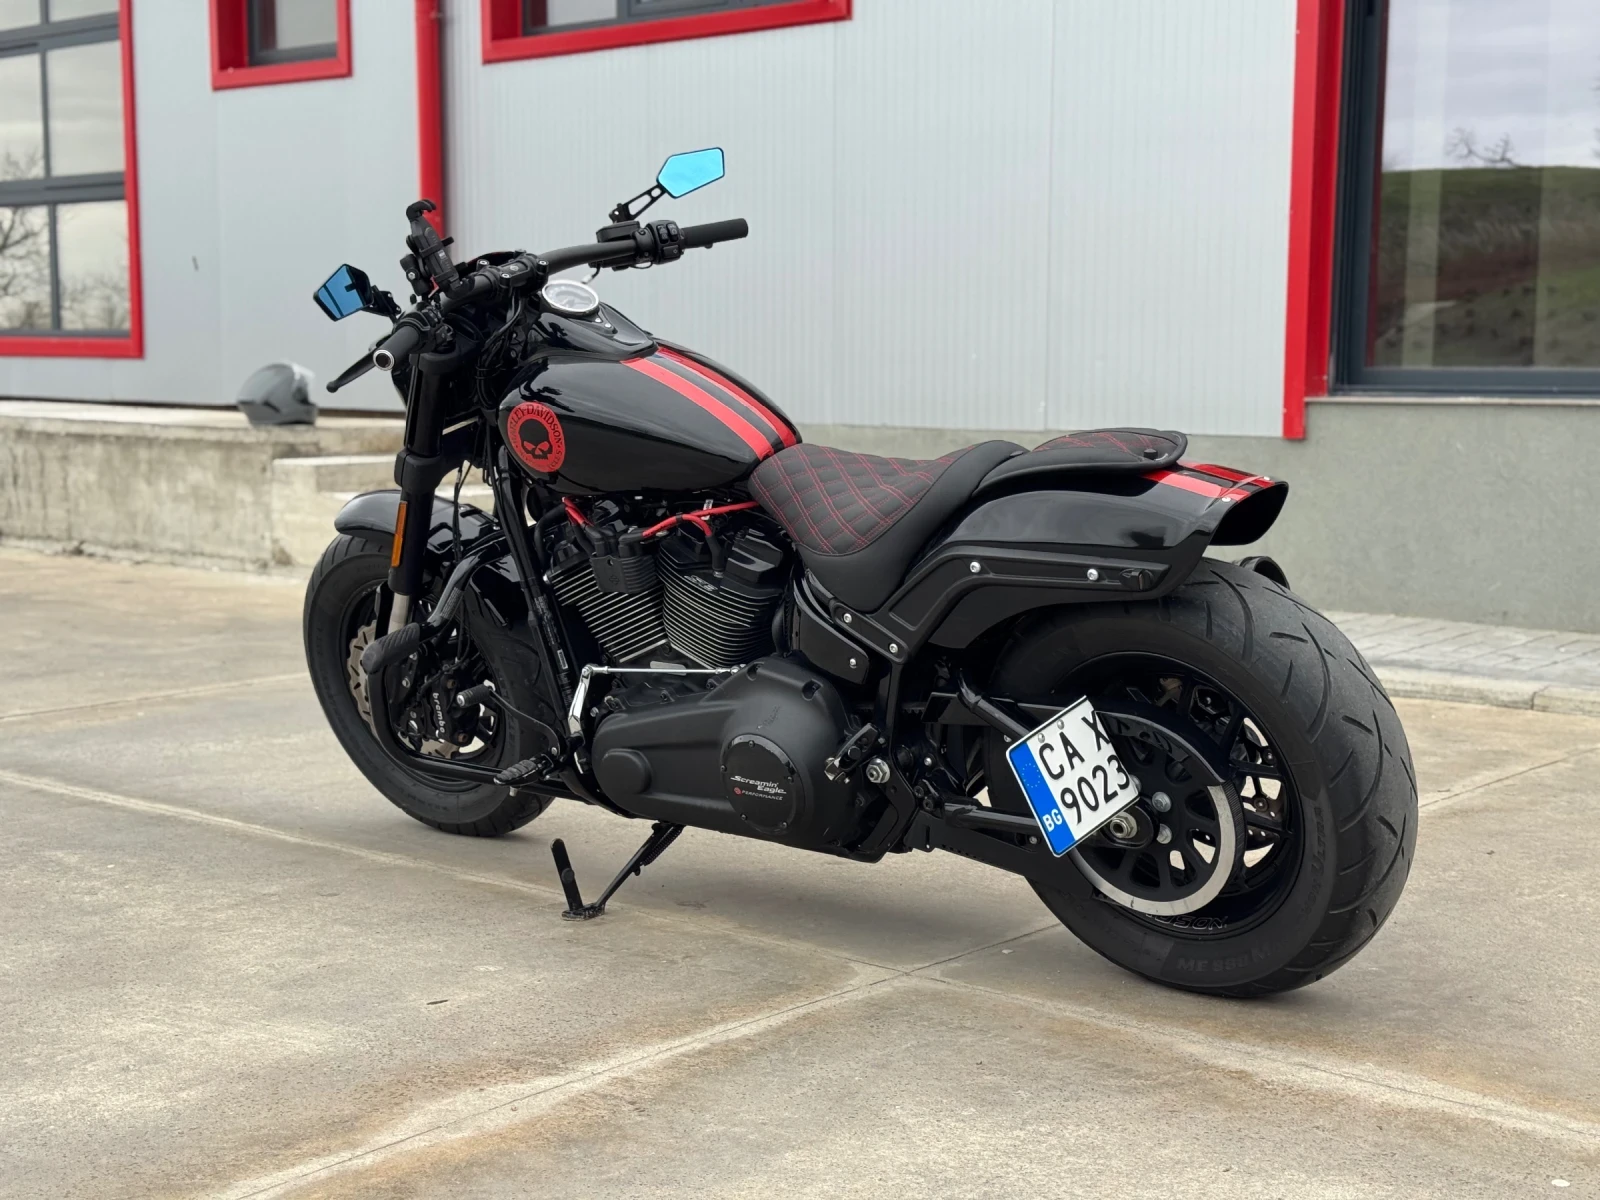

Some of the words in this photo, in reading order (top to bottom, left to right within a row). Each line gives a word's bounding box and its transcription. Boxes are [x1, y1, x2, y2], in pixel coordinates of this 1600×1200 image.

[433, 692, 446, 733] brembo
[1038, 731, 1085, 781] CA
[1081, 709, 1111, 752] X
[742, 790, 783, 801] PERFORMANCE
[757, 785, 787, 794] Eagle
[1060, 754, 1130, 825] 9023
[1042, 808, 1063, 833] BG
